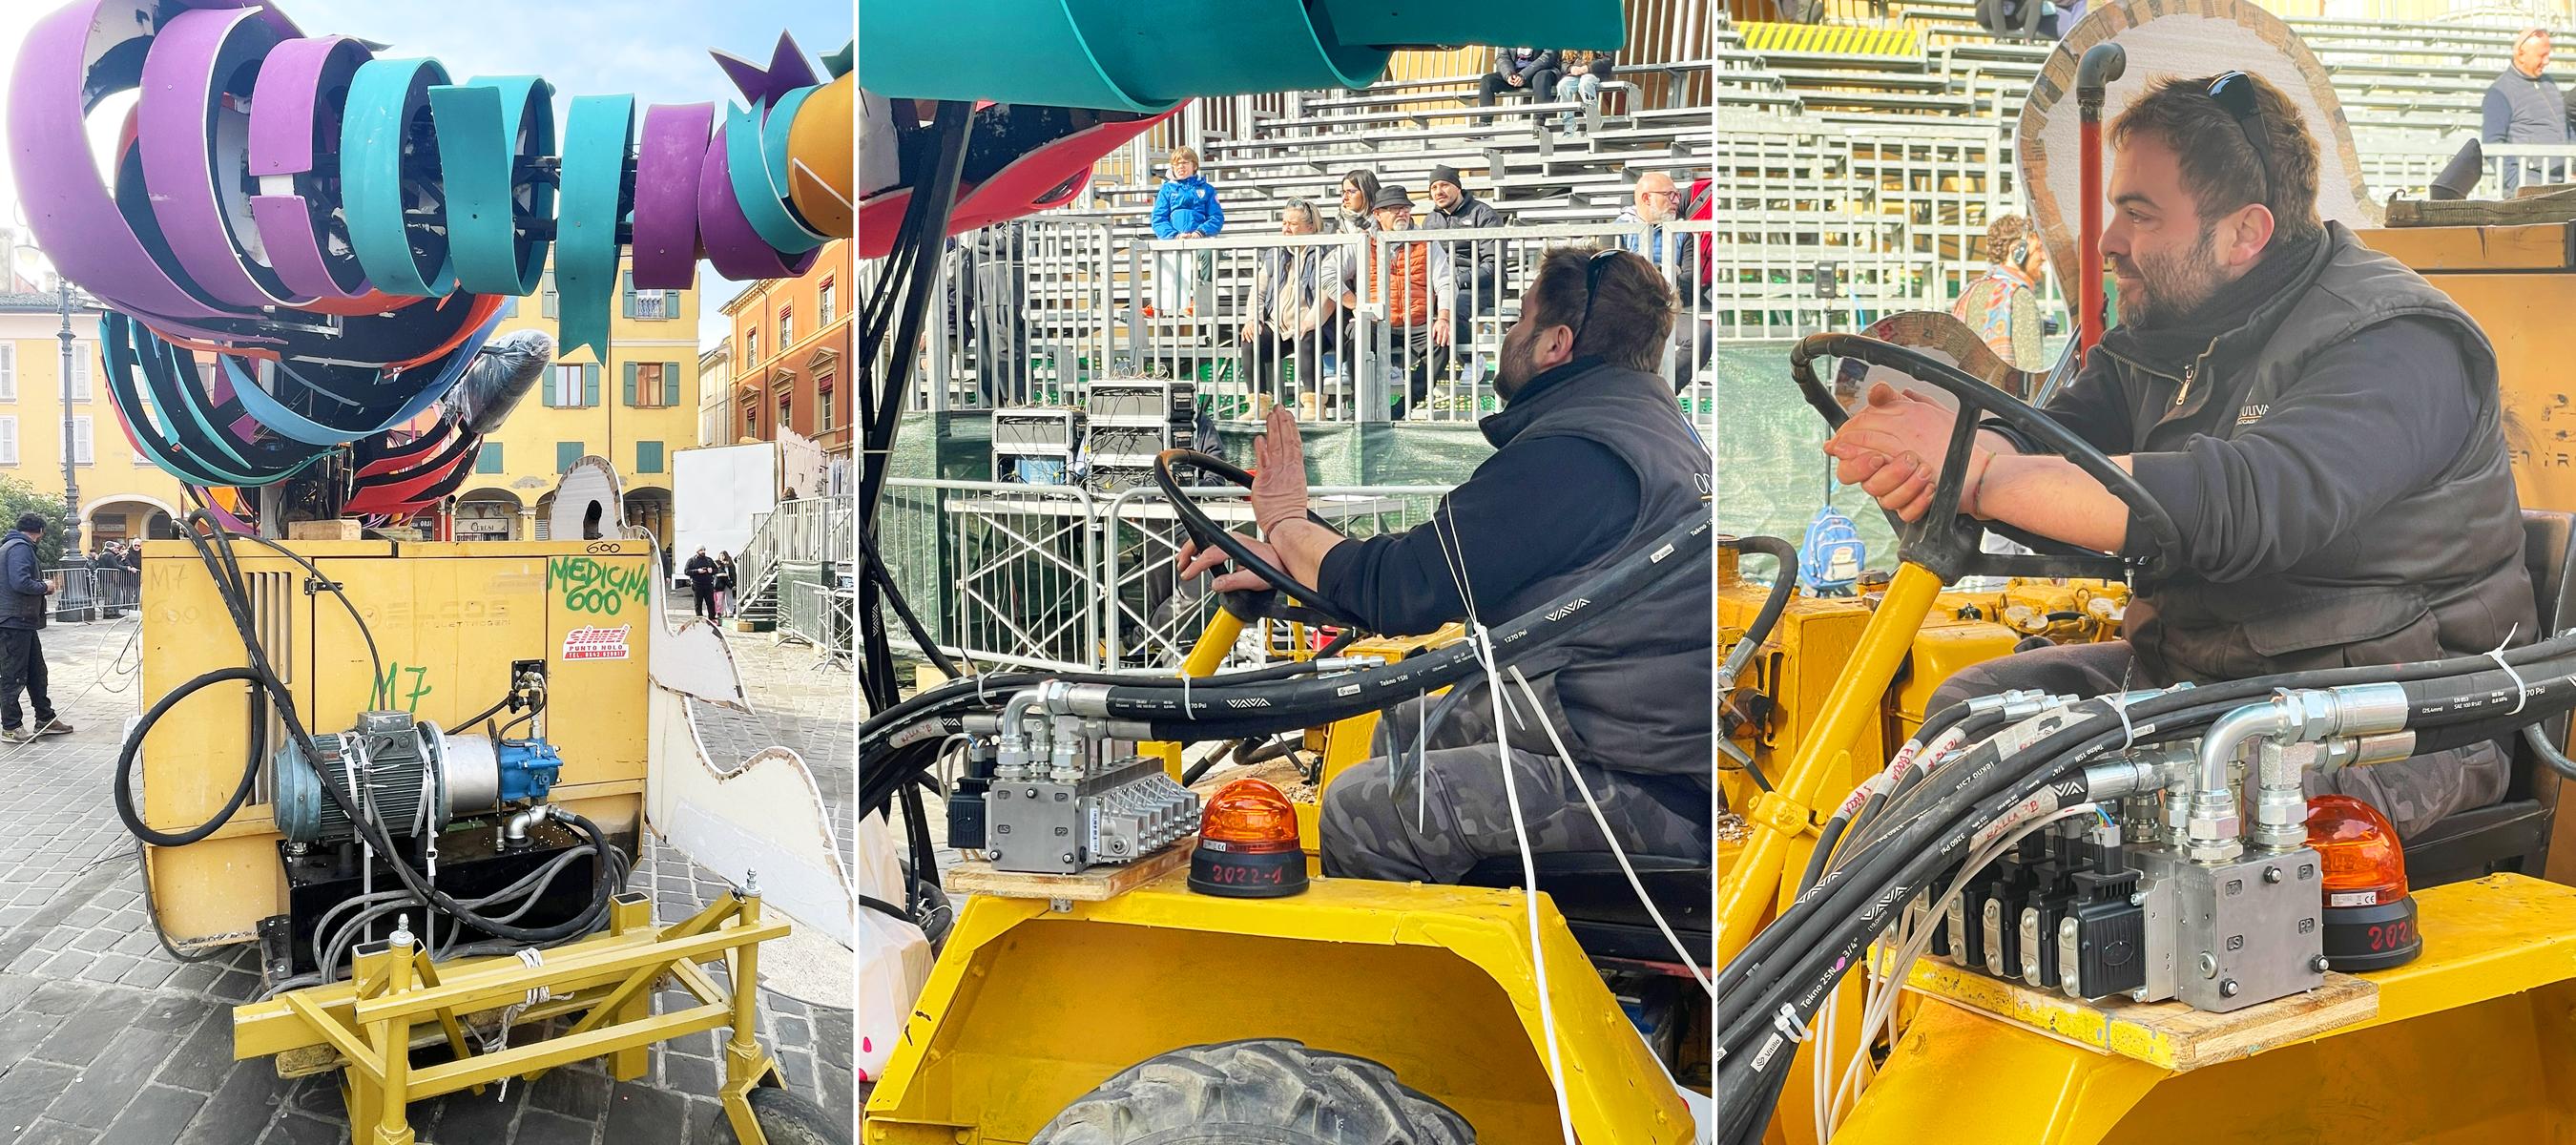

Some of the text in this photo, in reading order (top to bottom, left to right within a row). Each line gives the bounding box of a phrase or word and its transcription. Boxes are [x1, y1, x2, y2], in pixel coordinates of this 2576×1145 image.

[586, 541, 621, 553] 600
[548, 554, 650, 606] MEDICINA
[566, 585, 622, 615] 600
[367, 661, 432, 713] M7
[2087, 743, 2105, 756] Tekno
[1949, 832, 1966, 848] 3260
[1799, 937, 1859, 1009] Tekno 2SN 3/4"
[1764, 1038, 1781, 1057] Vitillo
